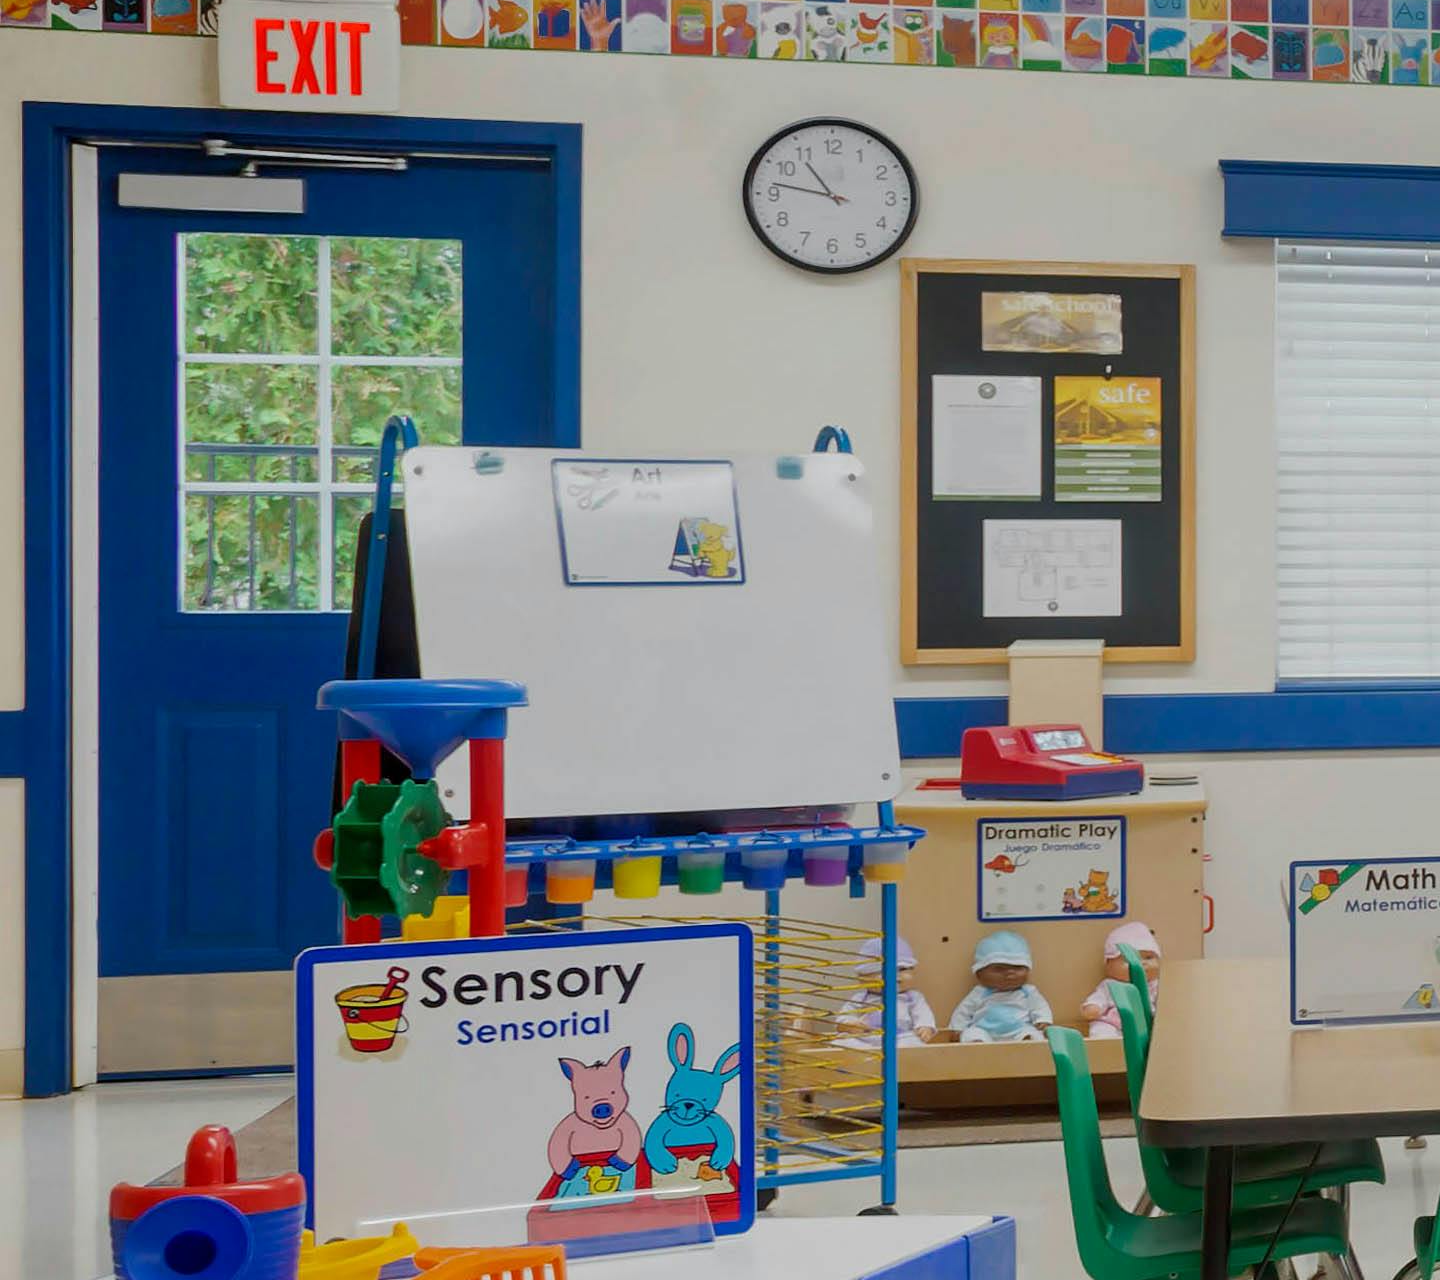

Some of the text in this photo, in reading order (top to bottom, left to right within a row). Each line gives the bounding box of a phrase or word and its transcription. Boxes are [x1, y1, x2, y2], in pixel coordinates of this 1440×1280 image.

[1393, 0, 1426, 23] Aa
[254, 17, 371, 97] EXIT
[795, 147, 813, 161] 11
[823, 139, 843, 155] 12
[856, 149, 863, 163] 1
[776, 161, 796, 176] 10
[875, 165, 888, 181] 2
[767, 186, 780, 202] 9
[884, 191, 897, 206] 3
[776, 211, 789, 227] 8
[875, 216, 887, 230] 4
[800, 231, 811, 247] 7
[826, 238, 839, 254] 6
[855, 233, 867, 248] 5
[1098, 382, 1154, 404] safe
[632, 468, 663, 484] Art
[984, 822, 1119, 841] Dramatic Play
[1003, 843, 1039, 855] Juego
[1364, 868, 1438, 892] Math
[419, 962, 646, 1009] Sensory
[456, 1008, 611, 1046] Sensorial
